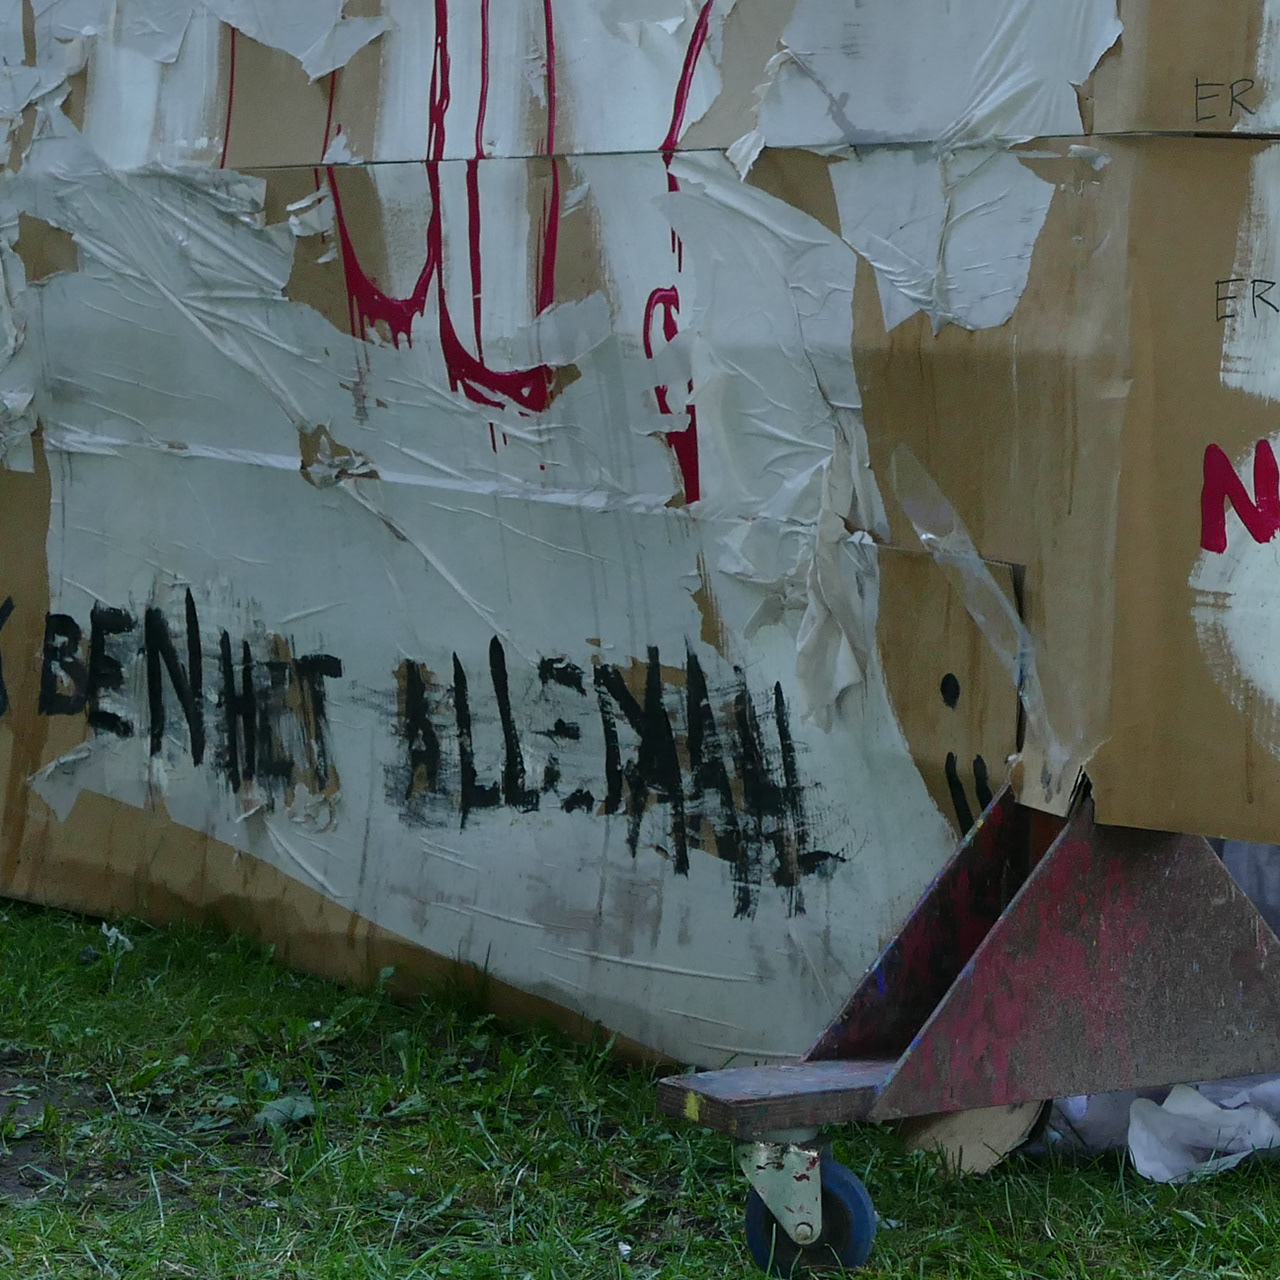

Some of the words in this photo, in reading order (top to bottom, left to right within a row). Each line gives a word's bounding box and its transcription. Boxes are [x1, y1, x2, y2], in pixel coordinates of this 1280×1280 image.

[1195, 78, 1256, 122] ER
[1215, 278, 1280, 323] ER
[38, 586, 207, 768] BEN
